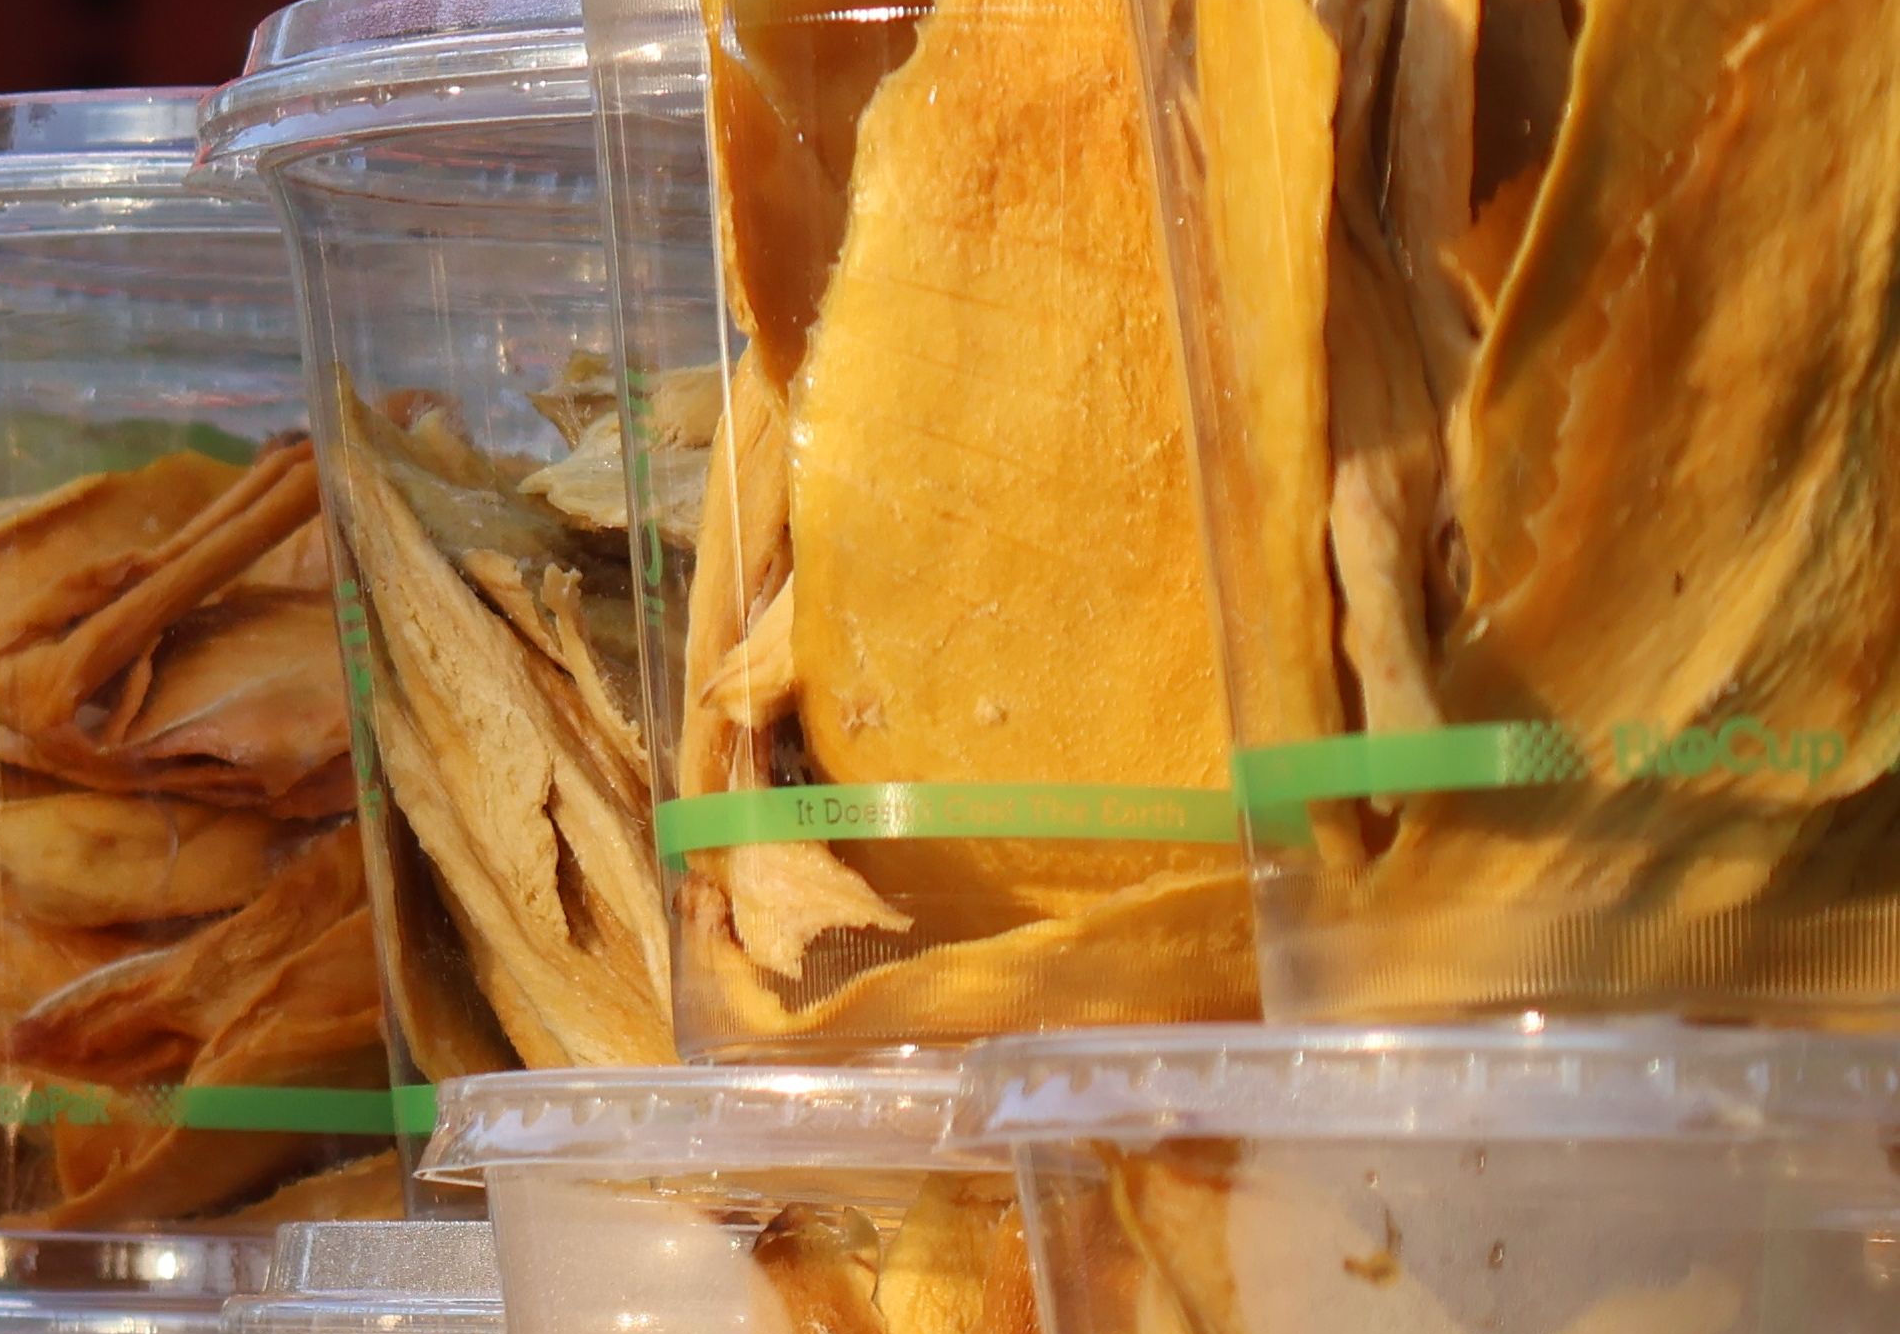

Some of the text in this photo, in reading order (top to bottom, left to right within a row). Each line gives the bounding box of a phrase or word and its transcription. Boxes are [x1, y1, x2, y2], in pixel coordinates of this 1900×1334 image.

[1613, 714, 1845, 786] BioCup
[796, 799, 814, 826] It
[942, 794, 1015, 826] Cost
[1026, 793, 1090, 828] The
[1101, 793, 1187, 829] Earth
